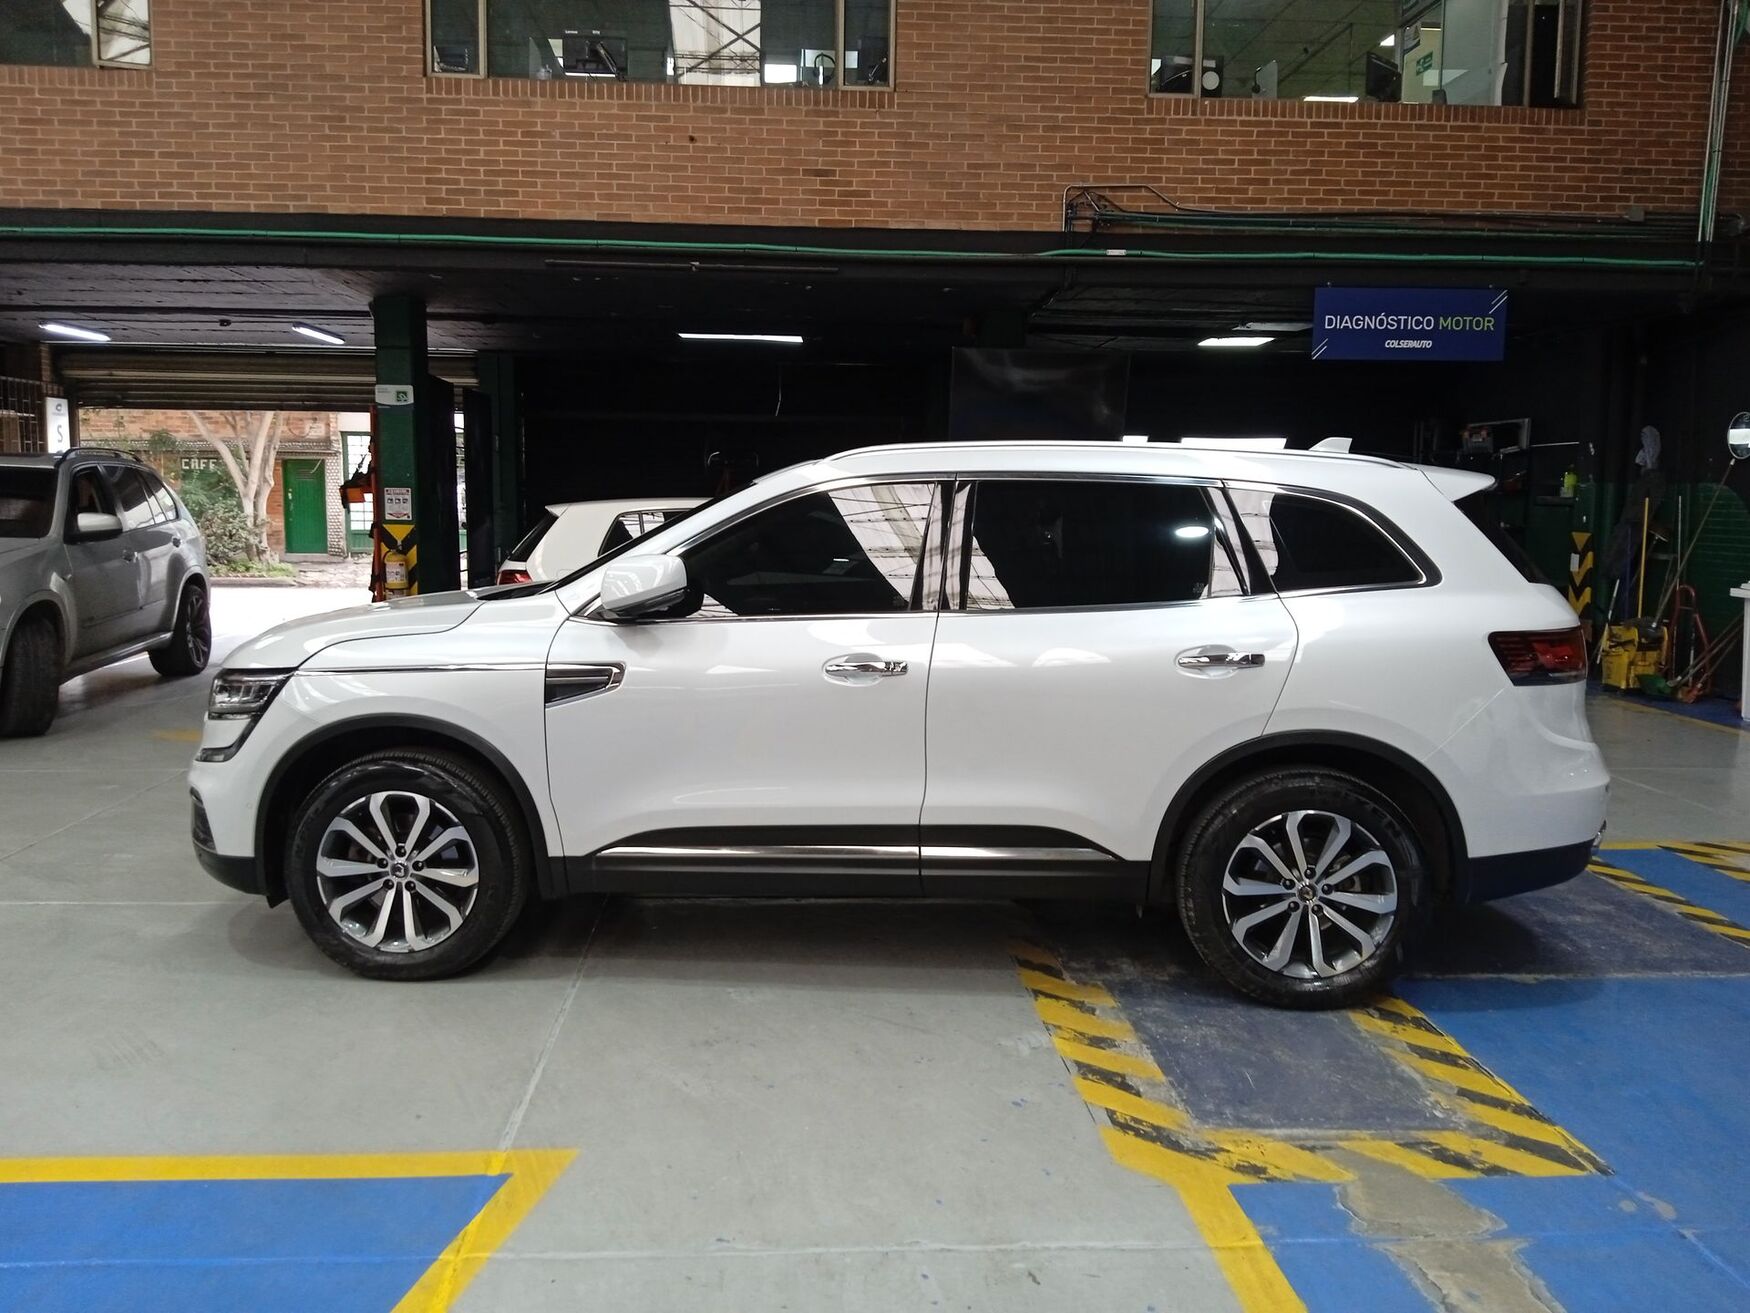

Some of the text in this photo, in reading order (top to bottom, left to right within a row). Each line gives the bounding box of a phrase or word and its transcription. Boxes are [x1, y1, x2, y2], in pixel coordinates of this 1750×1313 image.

[1325, 312, 1495, 331] DIAGNÓSTICO MOTOR
[1385, 339, 1433, 348] COLSERAUTO
